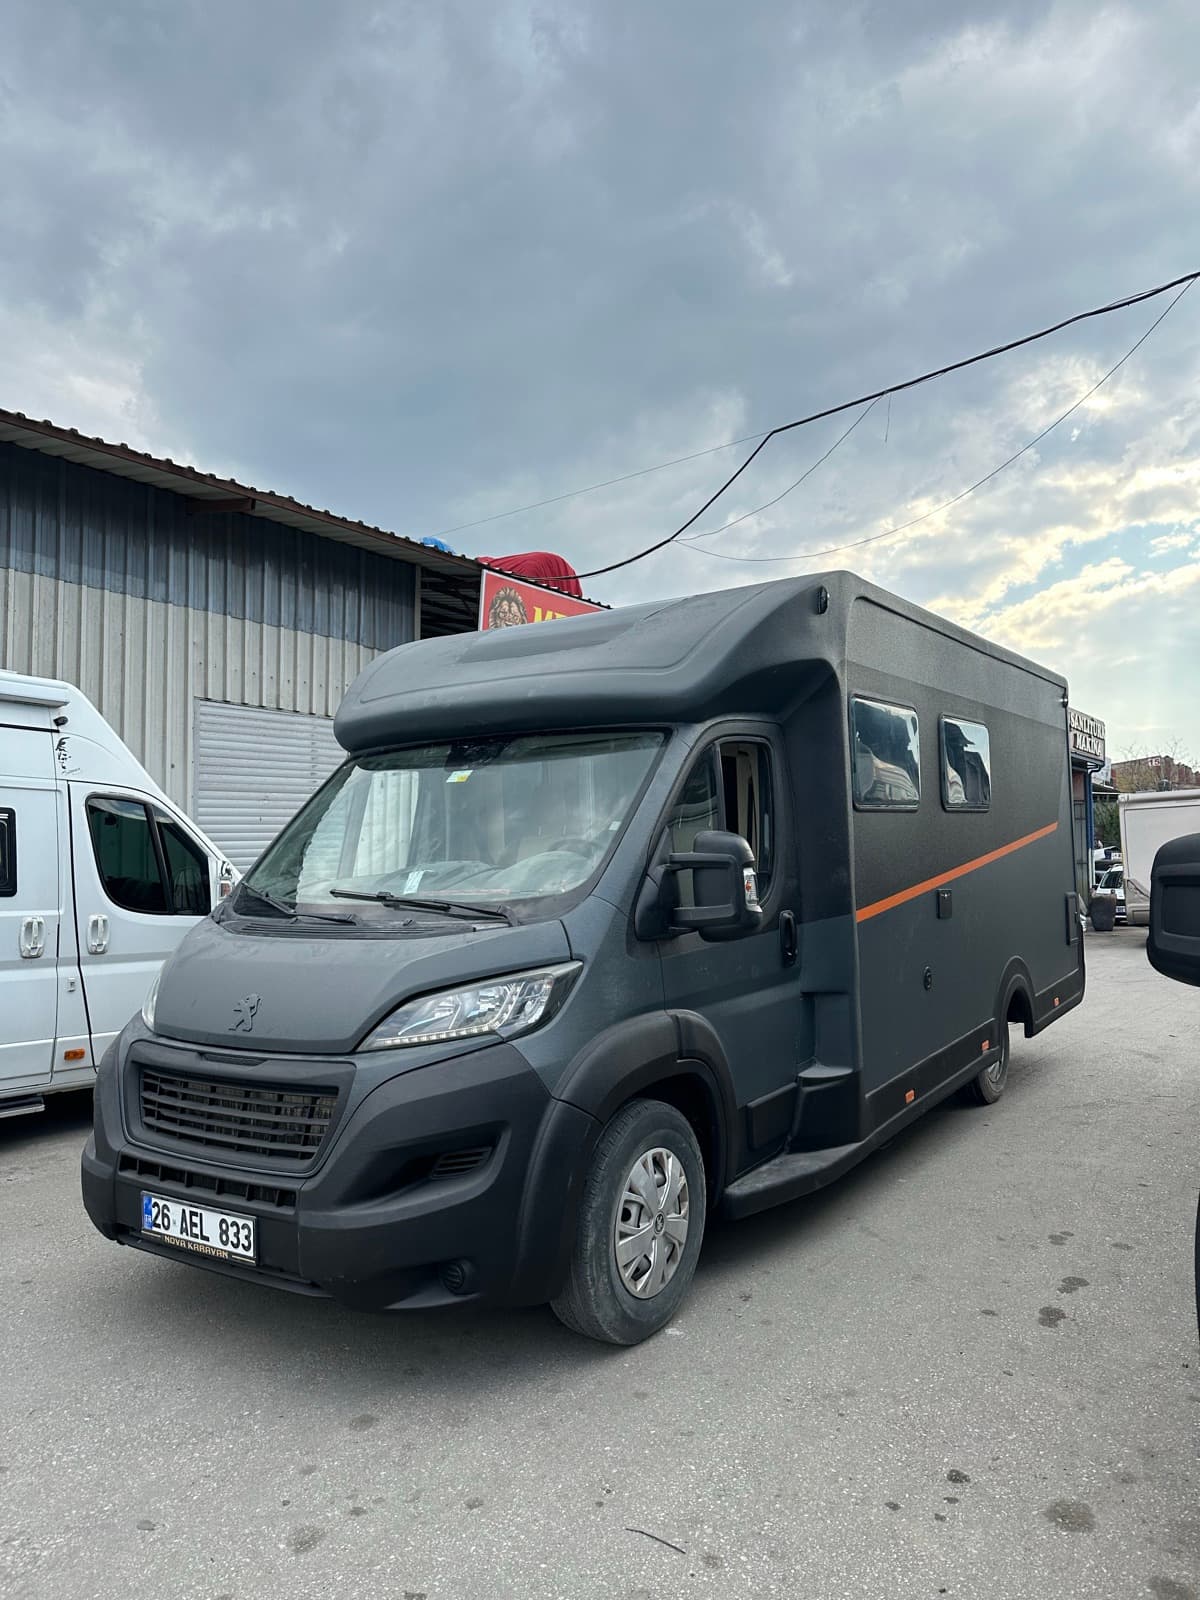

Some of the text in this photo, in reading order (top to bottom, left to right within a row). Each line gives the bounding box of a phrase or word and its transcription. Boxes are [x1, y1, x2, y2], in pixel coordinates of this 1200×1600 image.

[152, 1201, 252, 1252] 26 AEL 833
[164, 1235, 229, 1259] NOVA KARAVAN
